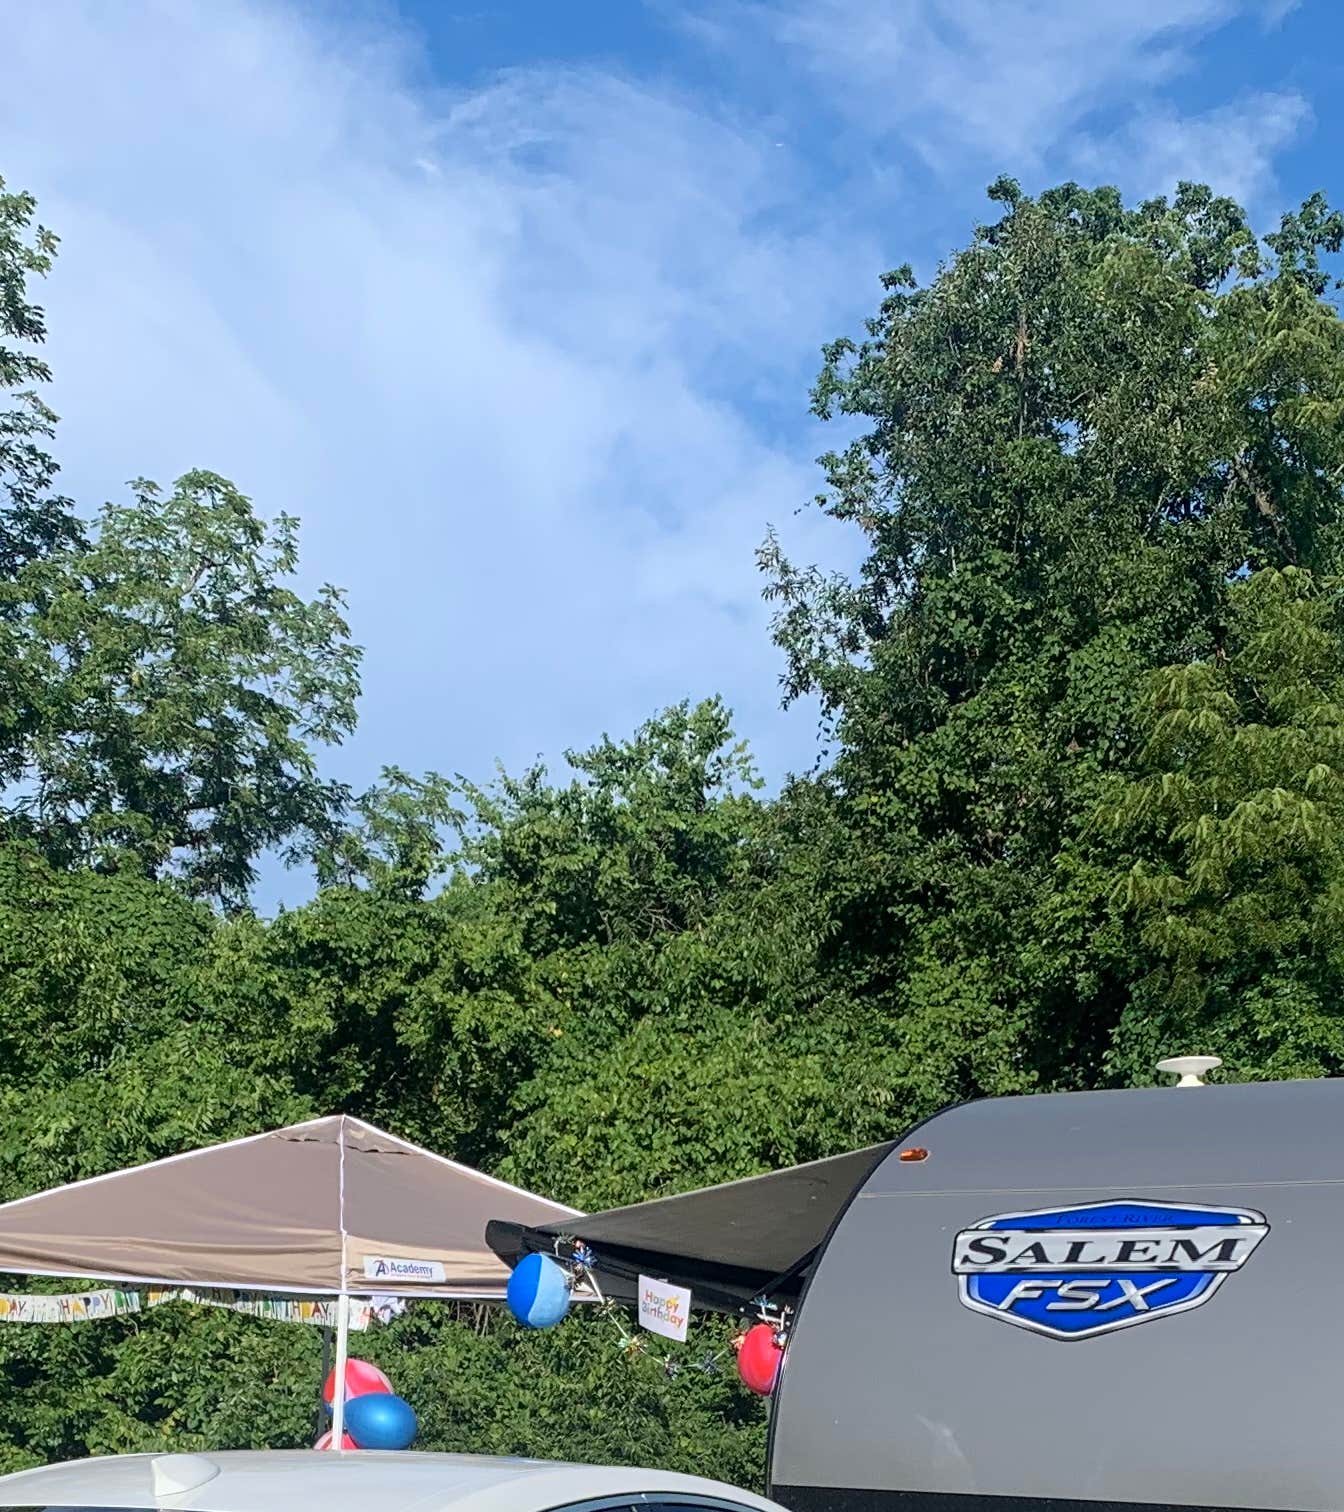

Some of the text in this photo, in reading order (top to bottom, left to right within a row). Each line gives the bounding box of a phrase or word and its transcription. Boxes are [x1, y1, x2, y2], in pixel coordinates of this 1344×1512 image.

[960, 1236, 1248, 1266] SALEM
[390, 1262, 433, 1278] Academy
[645, 1290, 679, 1312] Happy
[998, 1278, 1178, 1311] FSX
[642, 1301, 684, 1328] Birthday
